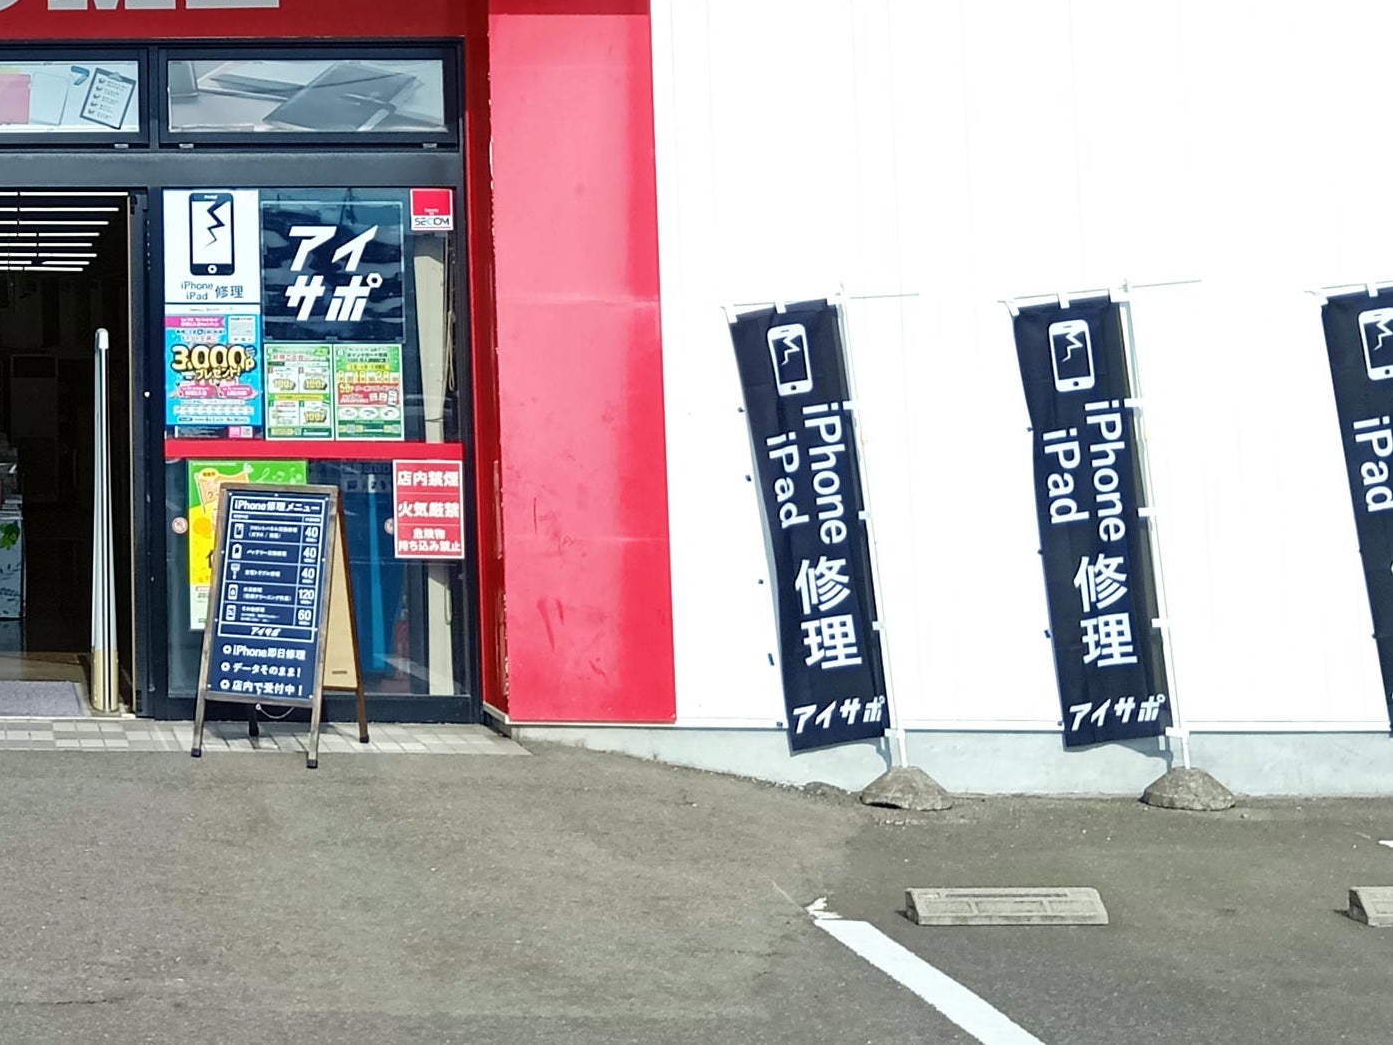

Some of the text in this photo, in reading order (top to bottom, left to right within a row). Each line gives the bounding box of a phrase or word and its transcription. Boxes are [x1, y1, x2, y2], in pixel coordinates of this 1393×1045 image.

[414, 216, 451, 227] SECOM
[288, 224, 378, 272] アイ
[181, 280, 214, 290] iPhone
[186, 291, 209, 301] iPad
[215, 285, 244, 299] 修理
[285, 272, 383, 322] サポ
[397, 470, 460, 488] 店内禁煙
[766, 430, 810, 529] iPad
[801, 401, 848, 545] iPhone
[1042, 427, 1090, 524] iPad
[1084, 398, 1126, 543] iPhone
[795, 555, 863, 670] 修理
[1073, 553, 1138, 668] 修理
[792, 695, 885, 734] アイサポ
[1069, 693, 1166, 732] アイサポ
